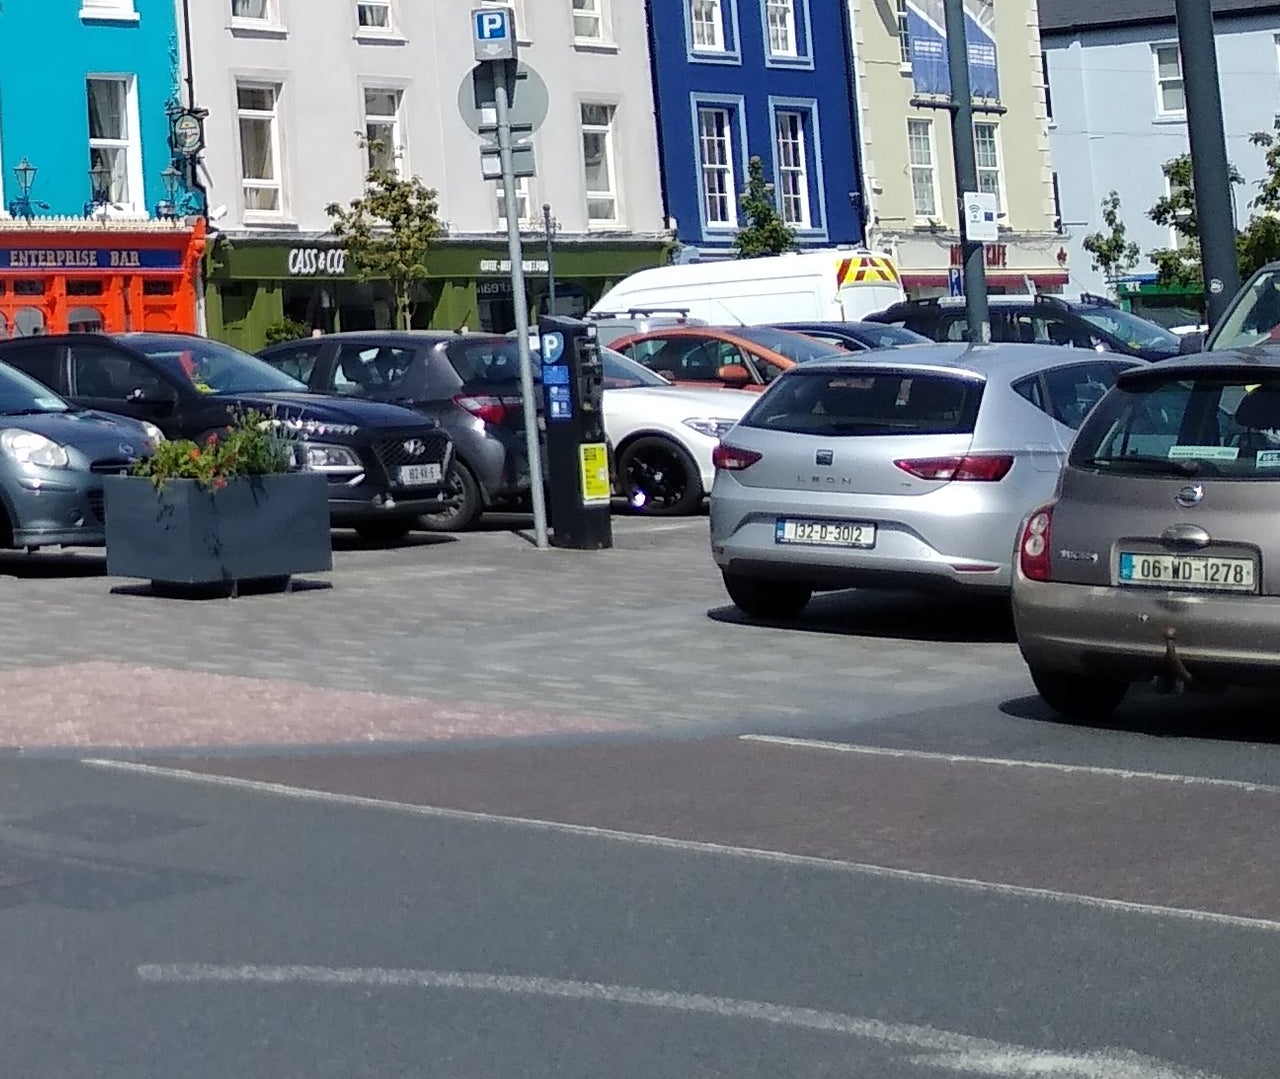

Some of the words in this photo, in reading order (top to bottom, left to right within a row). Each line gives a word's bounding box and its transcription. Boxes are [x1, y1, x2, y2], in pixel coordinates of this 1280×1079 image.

[483, 15, 502, 38] P
[10, 250, 97, 267] ENTERPRISE
[110, 251, 140, 267] BAR
[289, 248, 318, 274] CASS
[318, 251, 325, 270] &
[543, 335, 558, 358] P
[797, 475, 852, 484] LEON
[794, 522, 862, 542] 132-D-3012
[1141, 559, 1244, 583] 06-WD-1278
